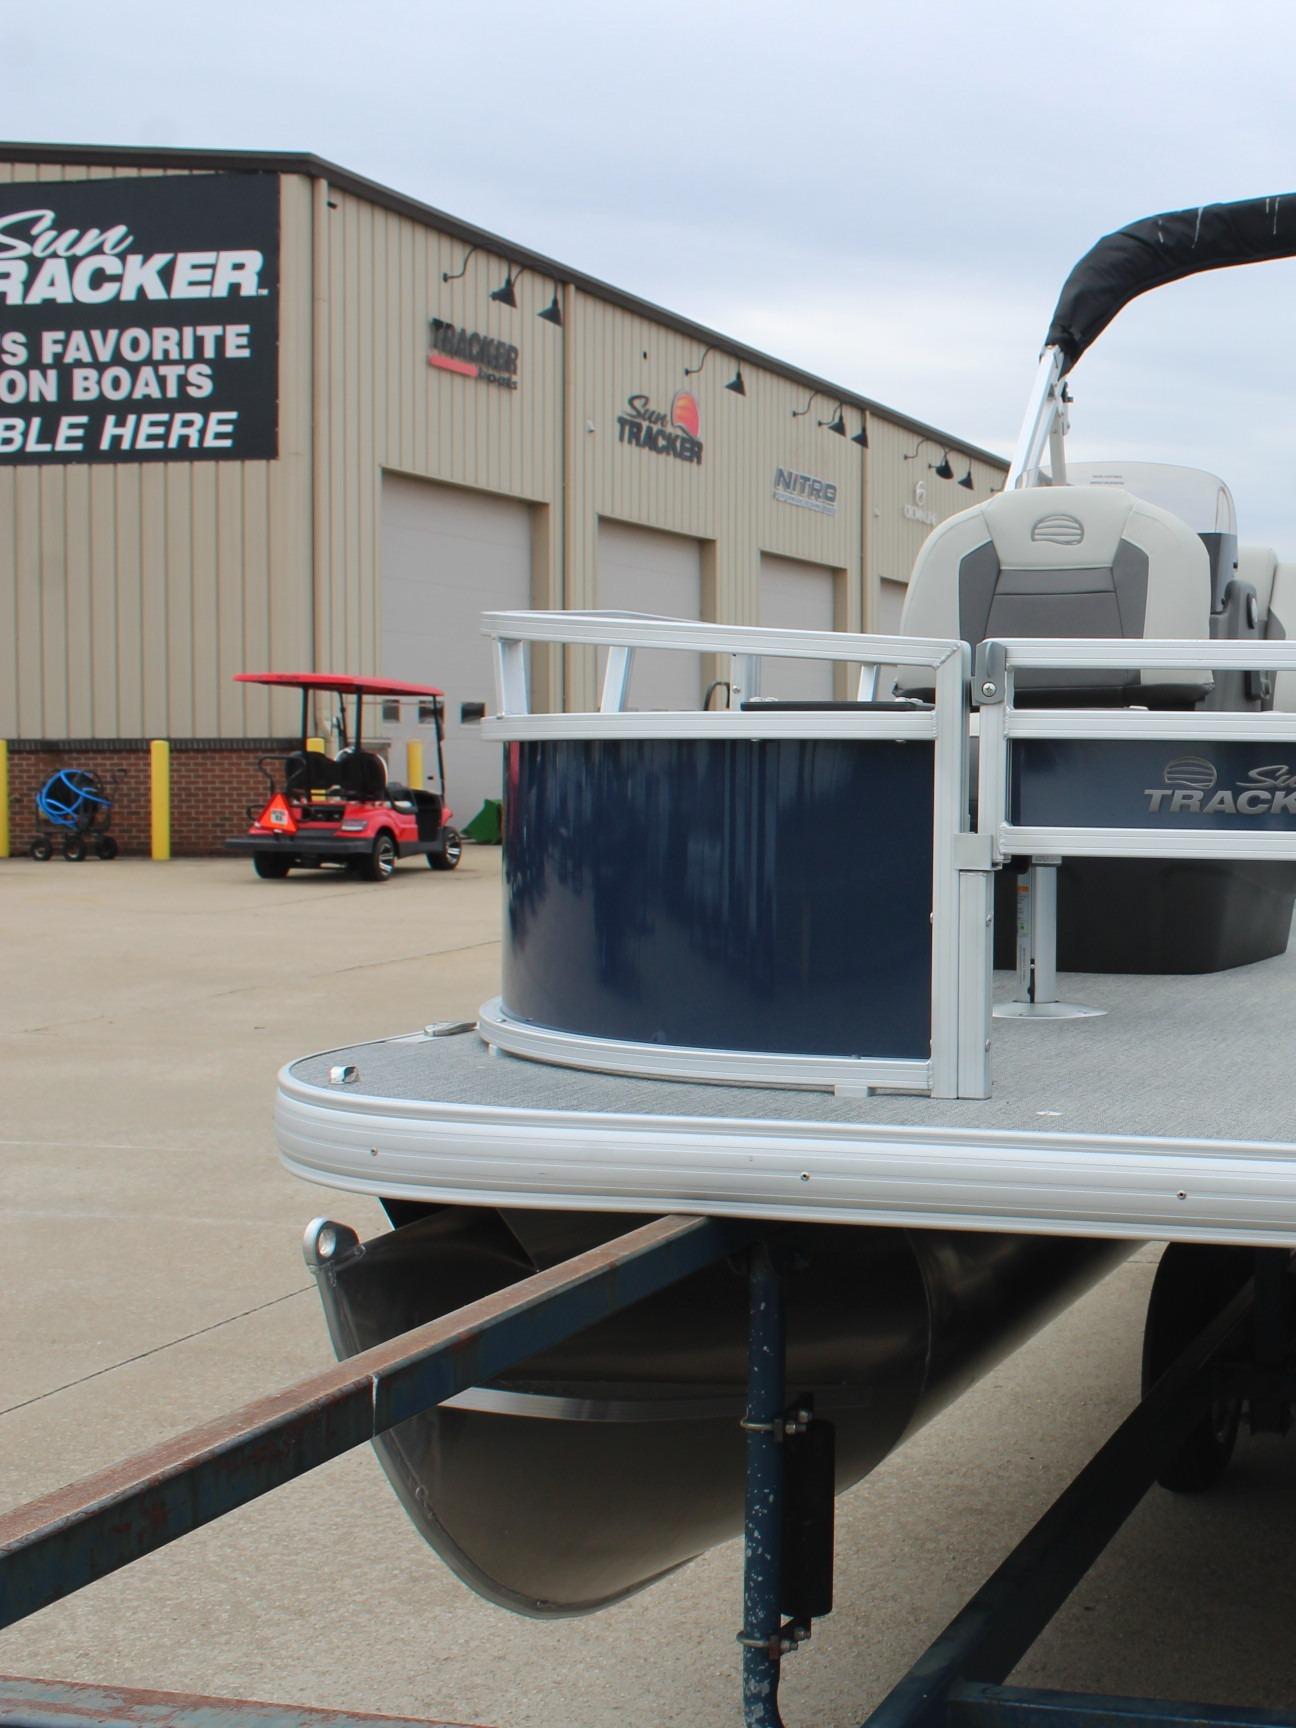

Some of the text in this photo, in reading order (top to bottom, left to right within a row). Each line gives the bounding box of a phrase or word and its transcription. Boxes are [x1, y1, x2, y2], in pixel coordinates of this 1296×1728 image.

[0, 208, 134, 258] Sun
[41, 324, 251, 364] FAVORITE
[430, 317, 519, 375] TRACKER
[72, 363, 214, 401] BOATS
[99, 411, 239, 450] HERE
[626, 394, 668, 428] Sun
[617, 415, 704, 466] TRACKER
[775, 467, 838, 503] NITRO
